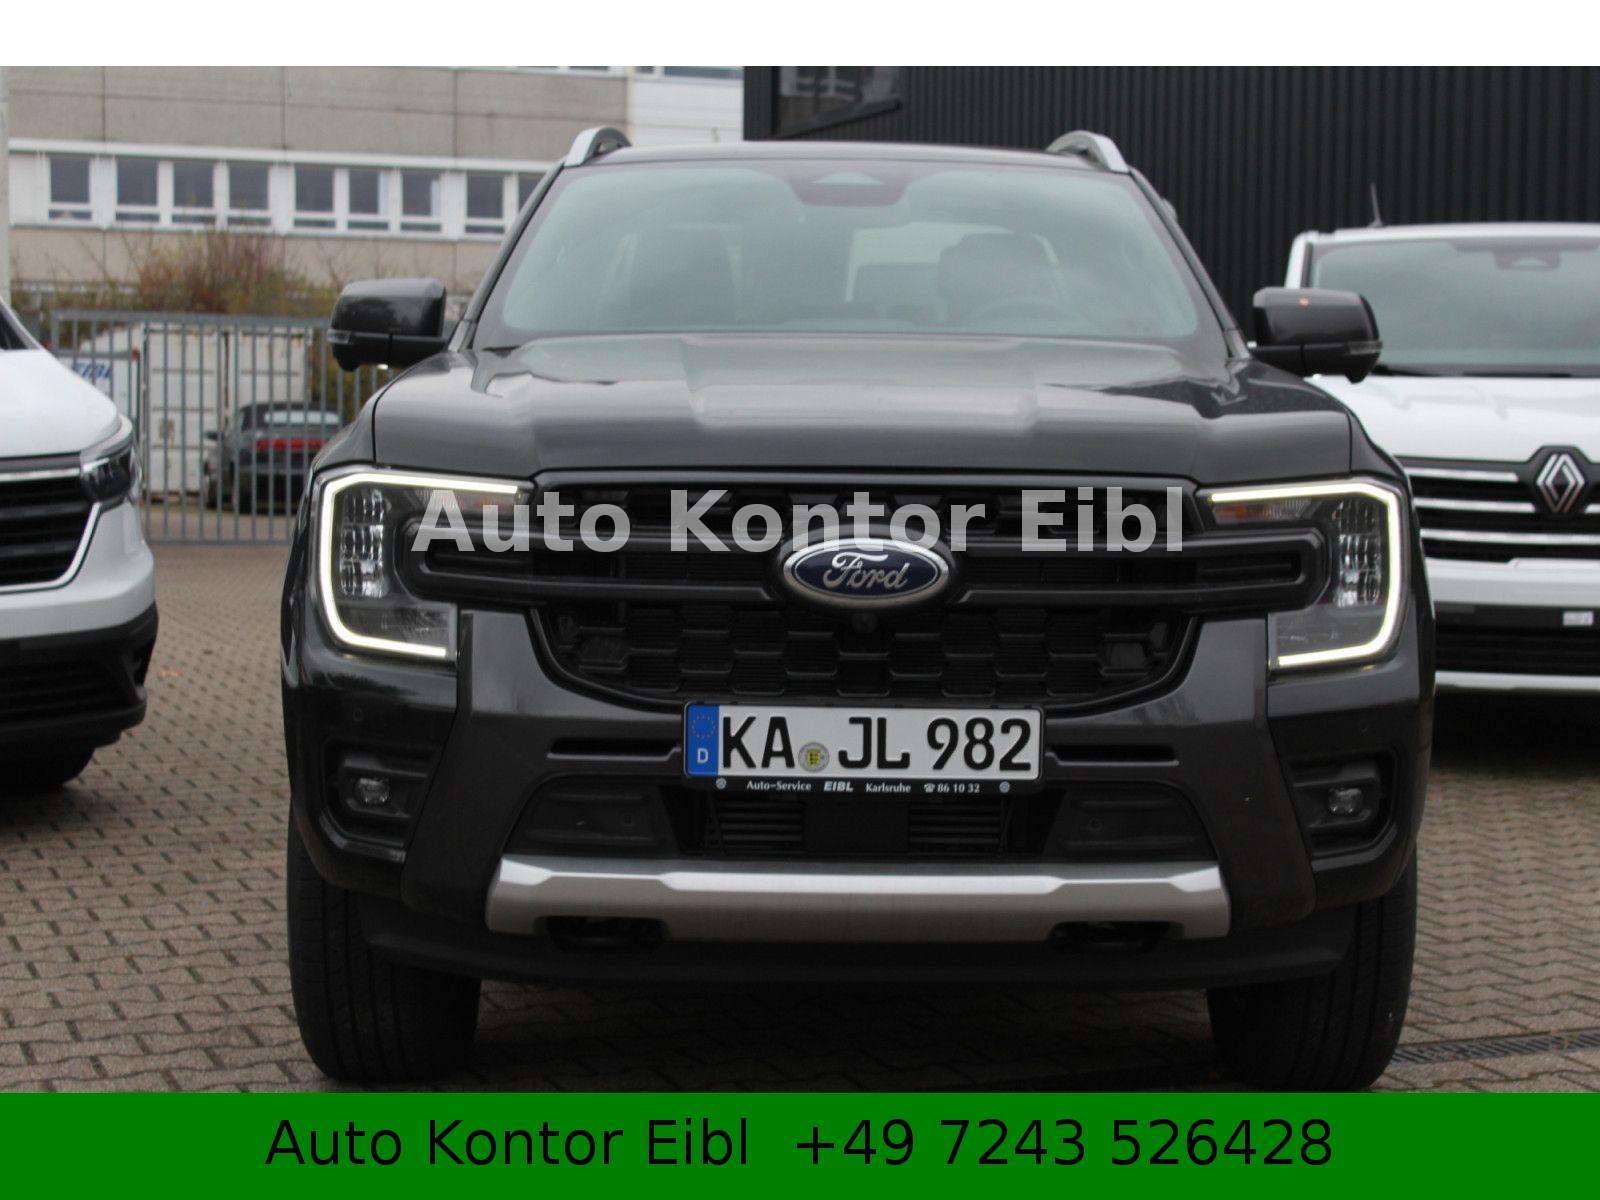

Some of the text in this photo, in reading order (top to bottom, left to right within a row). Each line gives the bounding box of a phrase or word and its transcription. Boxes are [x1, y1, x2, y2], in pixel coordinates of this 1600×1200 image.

[822, 551, 911, 590] Ford
[697, 748, 709, 764] D
[722, 716, 1032, 771] KA JL 982
[746, 780, 981, 794] Auto-Service EIBL Karlsruhe 86 10 32
